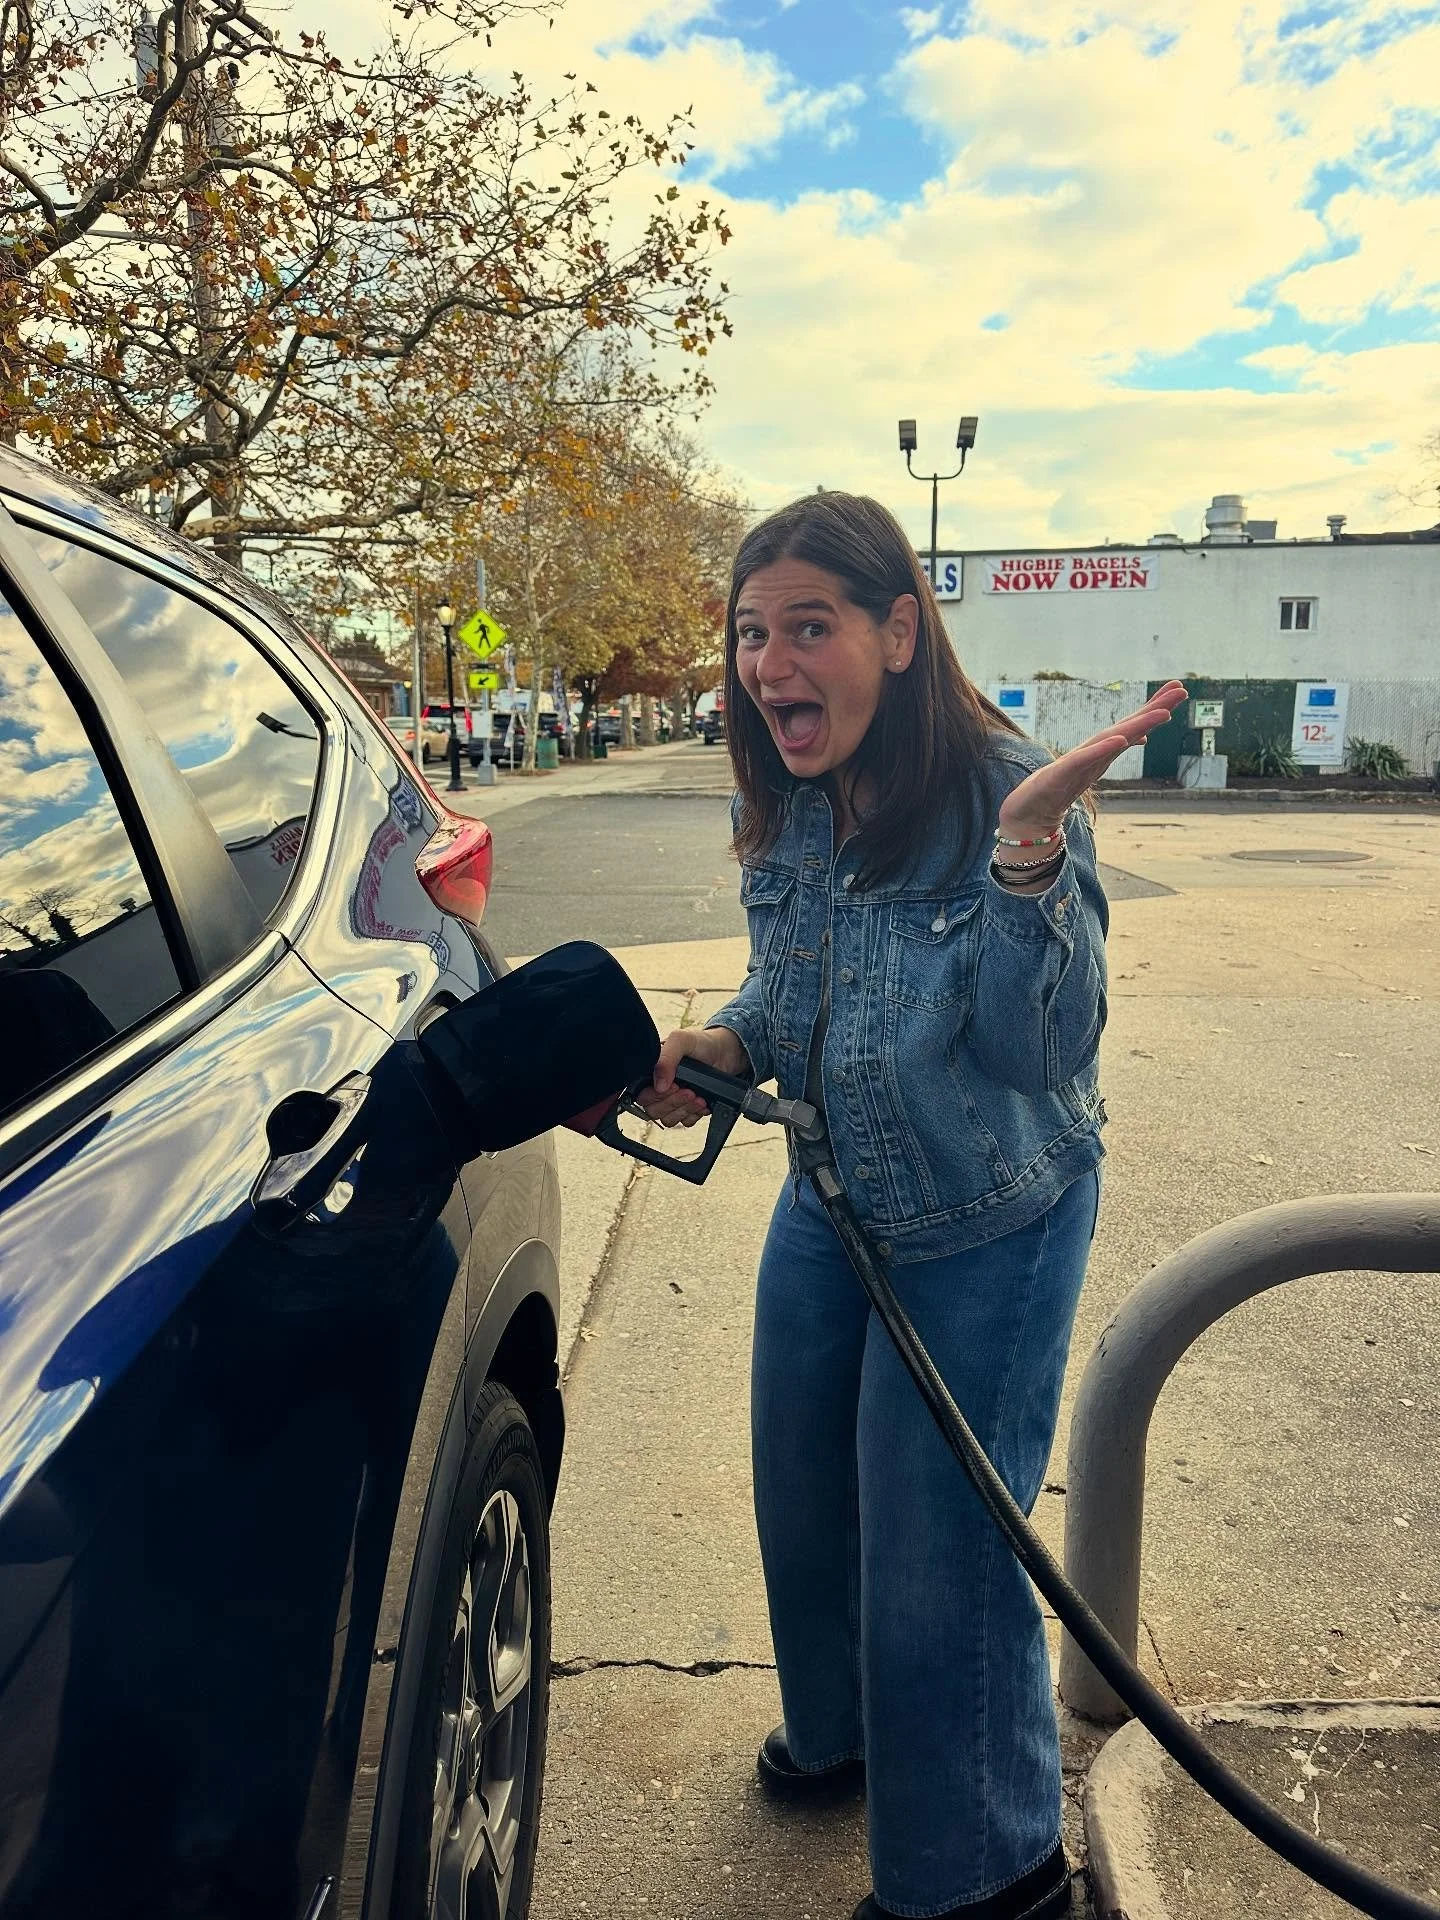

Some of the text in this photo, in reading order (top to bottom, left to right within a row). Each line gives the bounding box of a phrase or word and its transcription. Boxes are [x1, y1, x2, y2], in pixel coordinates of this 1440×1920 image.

[1001, 557, 1141, 571] HIGBIE BAGELS
[992, 570, 1149, 591] NOW OPEN
